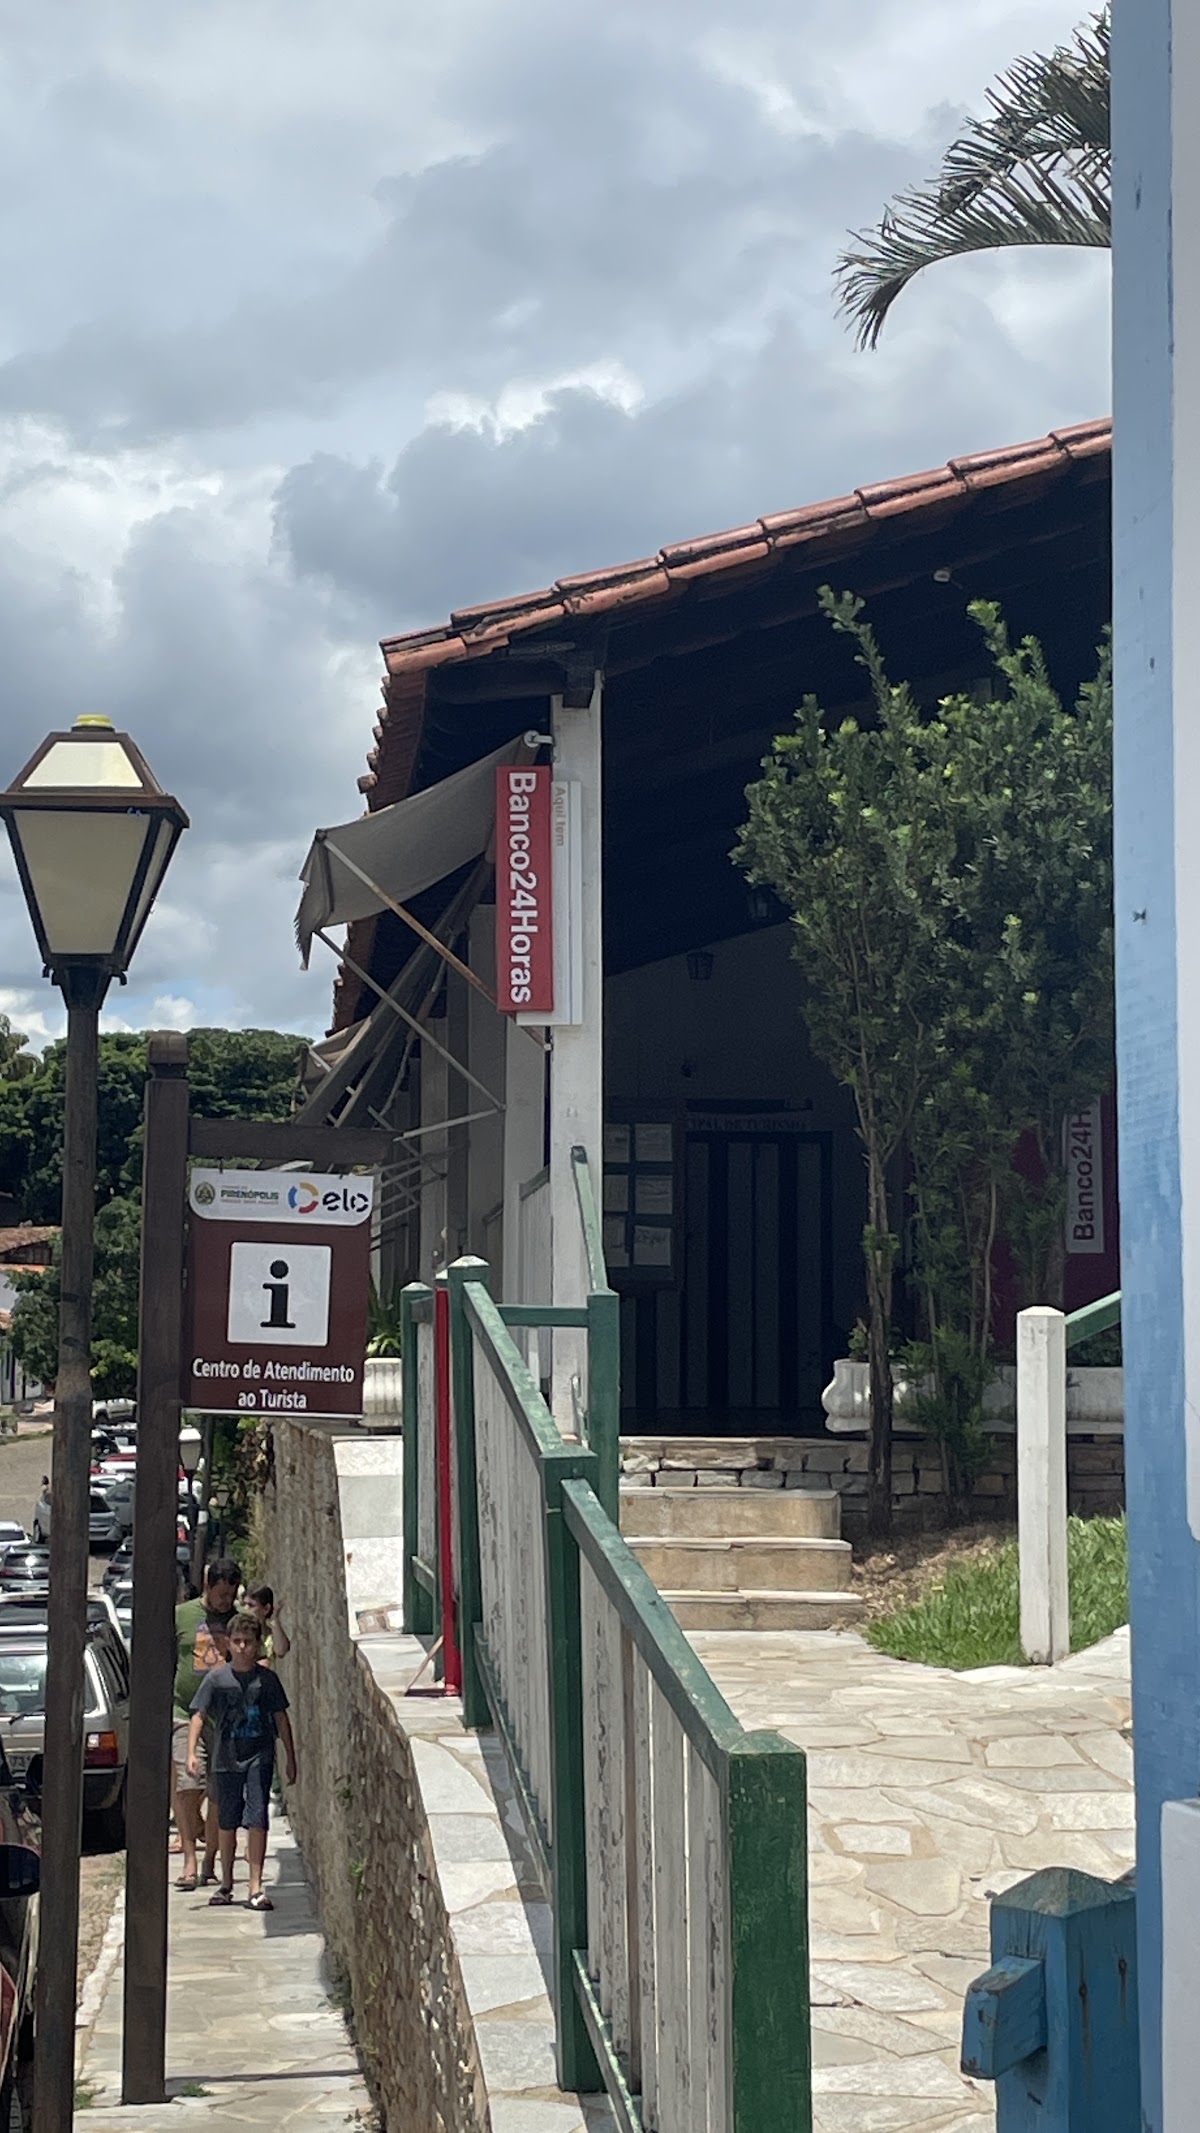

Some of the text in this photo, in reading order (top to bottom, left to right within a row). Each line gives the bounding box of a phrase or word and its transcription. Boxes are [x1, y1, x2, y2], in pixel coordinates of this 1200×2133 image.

[553, 787, 566, 846] Aqui tem
[508, 772, 539, 1003] Banco24Horas
[1071, 1110, 1095, 1241] Banco24H
[192, 1357, 355, 1383] Centro de Atendimento
[238, 1389, 307, 1409] ao Turista
